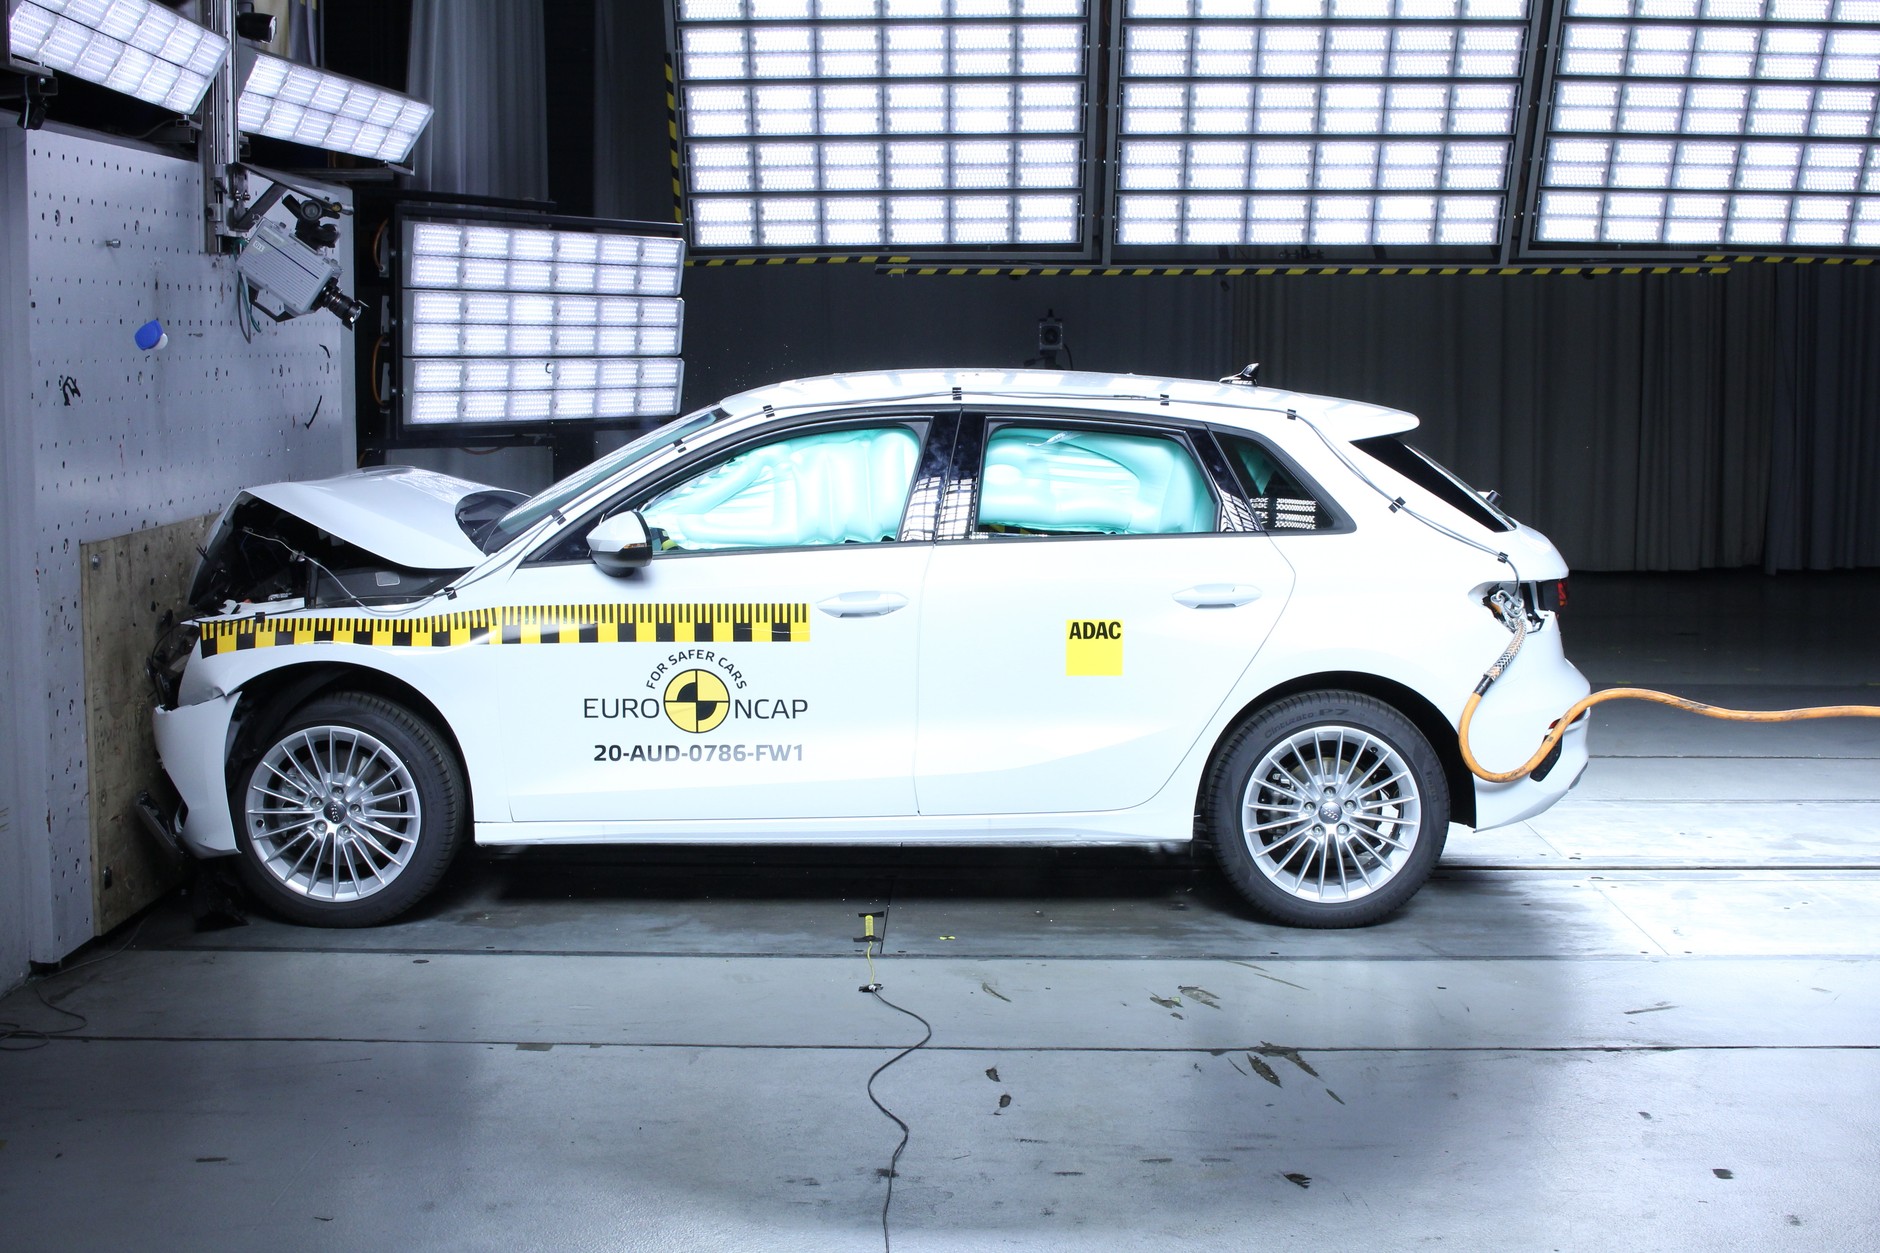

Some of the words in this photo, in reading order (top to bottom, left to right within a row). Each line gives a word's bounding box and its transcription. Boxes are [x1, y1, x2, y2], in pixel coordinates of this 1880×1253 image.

[1068, 621, 1122, 640] ADAC
[645, 661, 669, 690] FOR
[667, 649, 715, 667] SAFER
[717, 656, 748, 690] CARS
[583, 697, 660, 719] EURO
[734, 698, 809, 720] NCAP
[1318, 708, 1350, 716] P7
[593, 744, 804, 762] 20-AUD-0786-FW1
